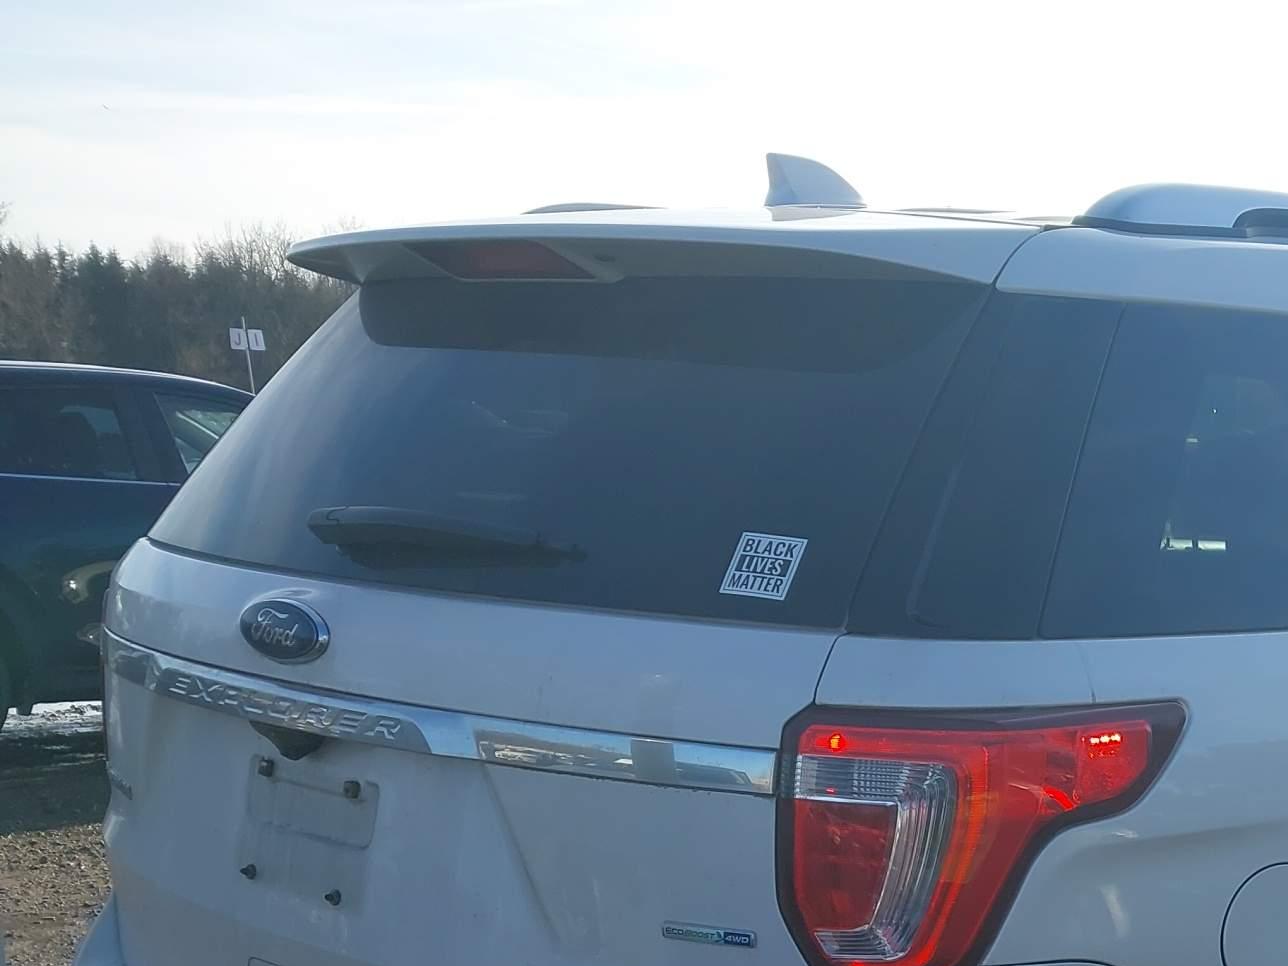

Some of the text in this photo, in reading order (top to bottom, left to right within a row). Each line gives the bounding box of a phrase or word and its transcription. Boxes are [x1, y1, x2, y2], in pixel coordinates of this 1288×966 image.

[742, 538, 799, 559] BLACK
[741, 556, 785, 576] LIVES
[727, 573, 784, 594] MATTER
[251, 608, 299, 647] Ford
[168, 676, 401, 740] EXPLORER
[725, 934, 750, 945] 4WD
